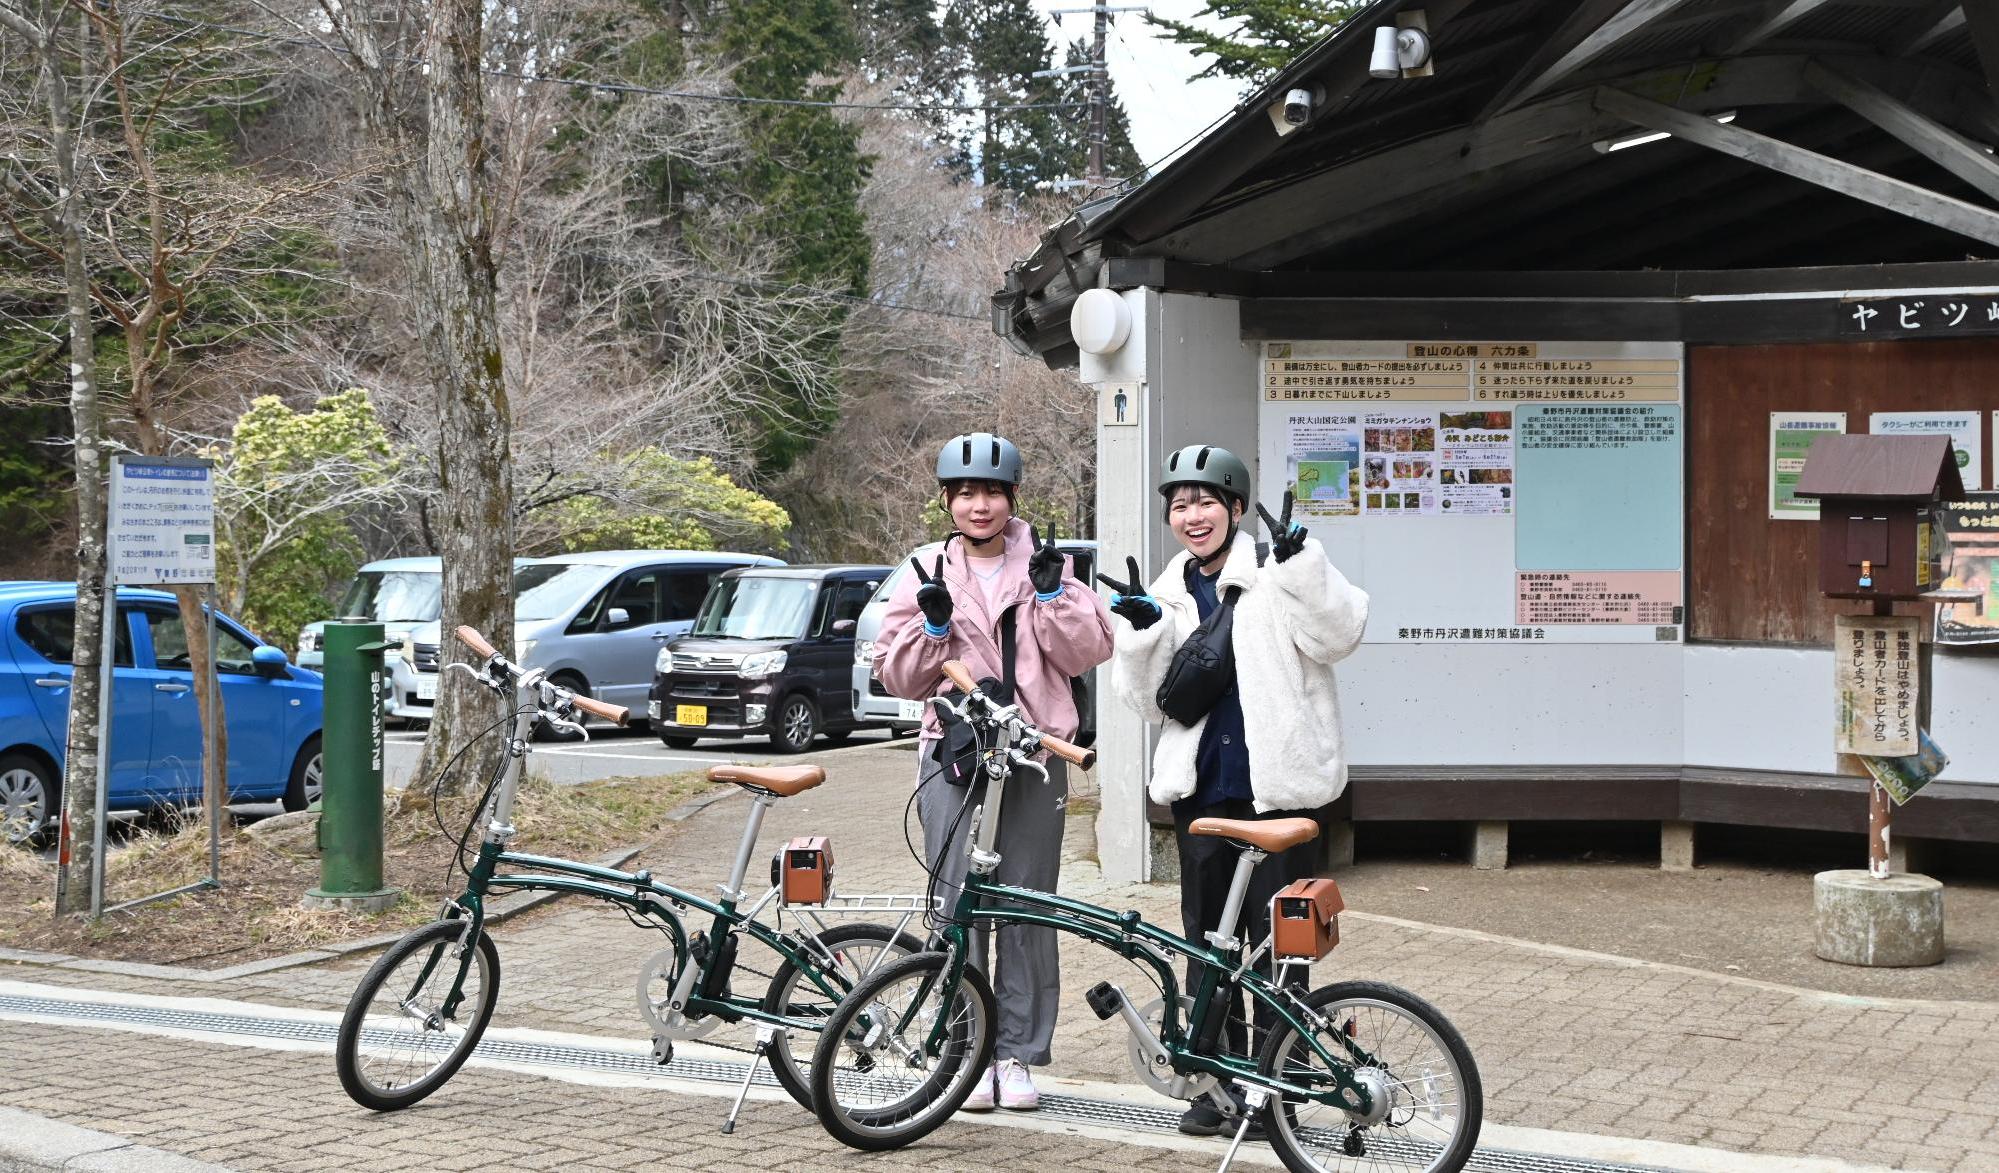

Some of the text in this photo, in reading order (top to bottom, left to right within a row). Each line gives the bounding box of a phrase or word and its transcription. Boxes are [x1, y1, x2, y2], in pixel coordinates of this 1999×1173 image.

[1414, 345, 1478, 357] 登山の心得
[1479, 361, 1593, 371] 4 仲間は共に行動しましょう
[1270, 376, 1416, 386] 2 途中で引き返す勇気を持ちましょう
[1479, 376, 1634, 386] 5 迷ったら下らず来た道を戻りましょう
[1270, 390, 1391, 399] 3 日暮れまでに下山しましょう
[1479, 390, 1626, 399] 6 すれ違う時は上りを優先しましょう
[1289, 416, 1357, 425] 丹沢大山国定公園
[1881, 420, 1968, 429] タクシーがご利用できます
[1398, 628, 1545, 639] 秦野市丹沢遭難対策協議会
[1852, 629, 1866, 689] 登りましょう。
[1874, 630, 1887, 742] 登山者カードを出してから
[1896, 630, 1911, 742] 単独登山はやめましょう。
